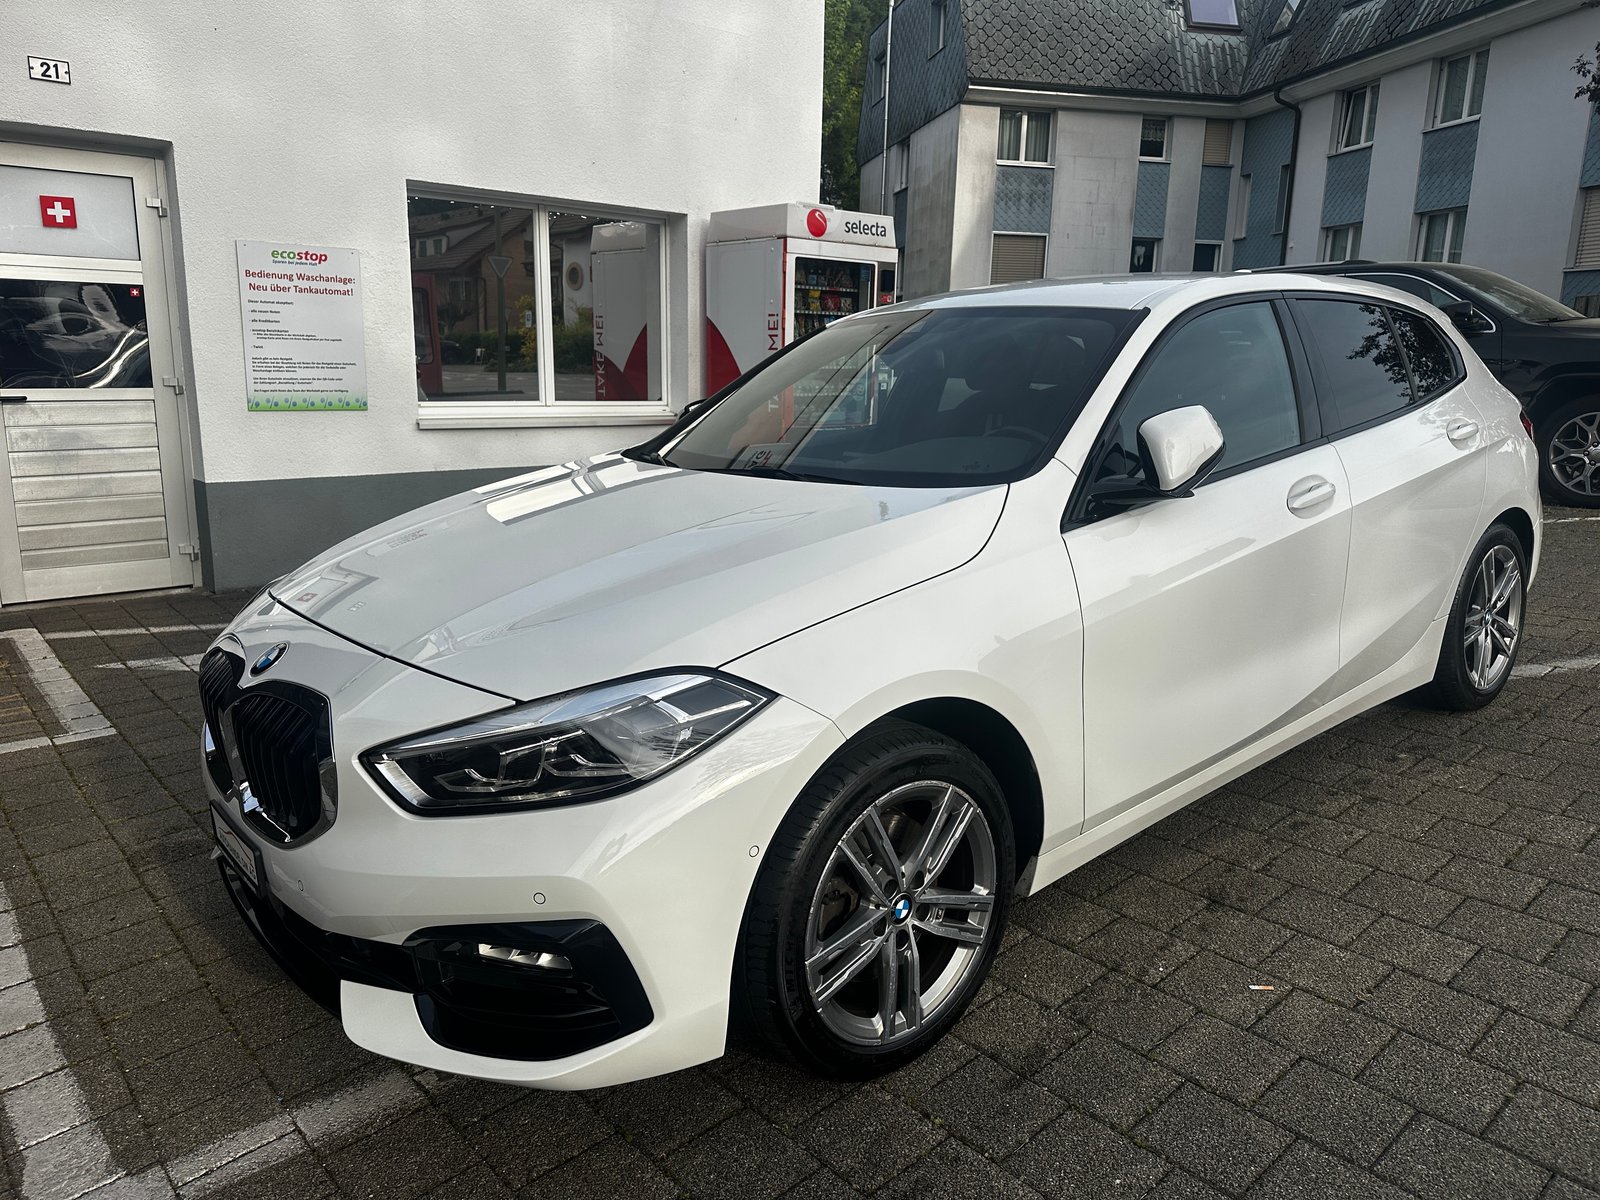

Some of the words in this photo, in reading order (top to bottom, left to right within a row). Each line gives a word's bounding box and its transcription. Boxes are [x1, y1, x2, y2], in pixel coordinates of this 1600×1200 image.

[40, 61, 60, 80] 21
[844, 219, 887, 237] selecta
[271, 249, 328, 264] ecostop
[245, 269, 294, 282] Bedienung
[295, 272, 356, 286] Waschanlage:
[248, 282, 268, 291] Neu
[270, 283, 291, 293] über
[293, 284, 354, 297] Tankautomat!
[767, 313, 779, 351] ME!
